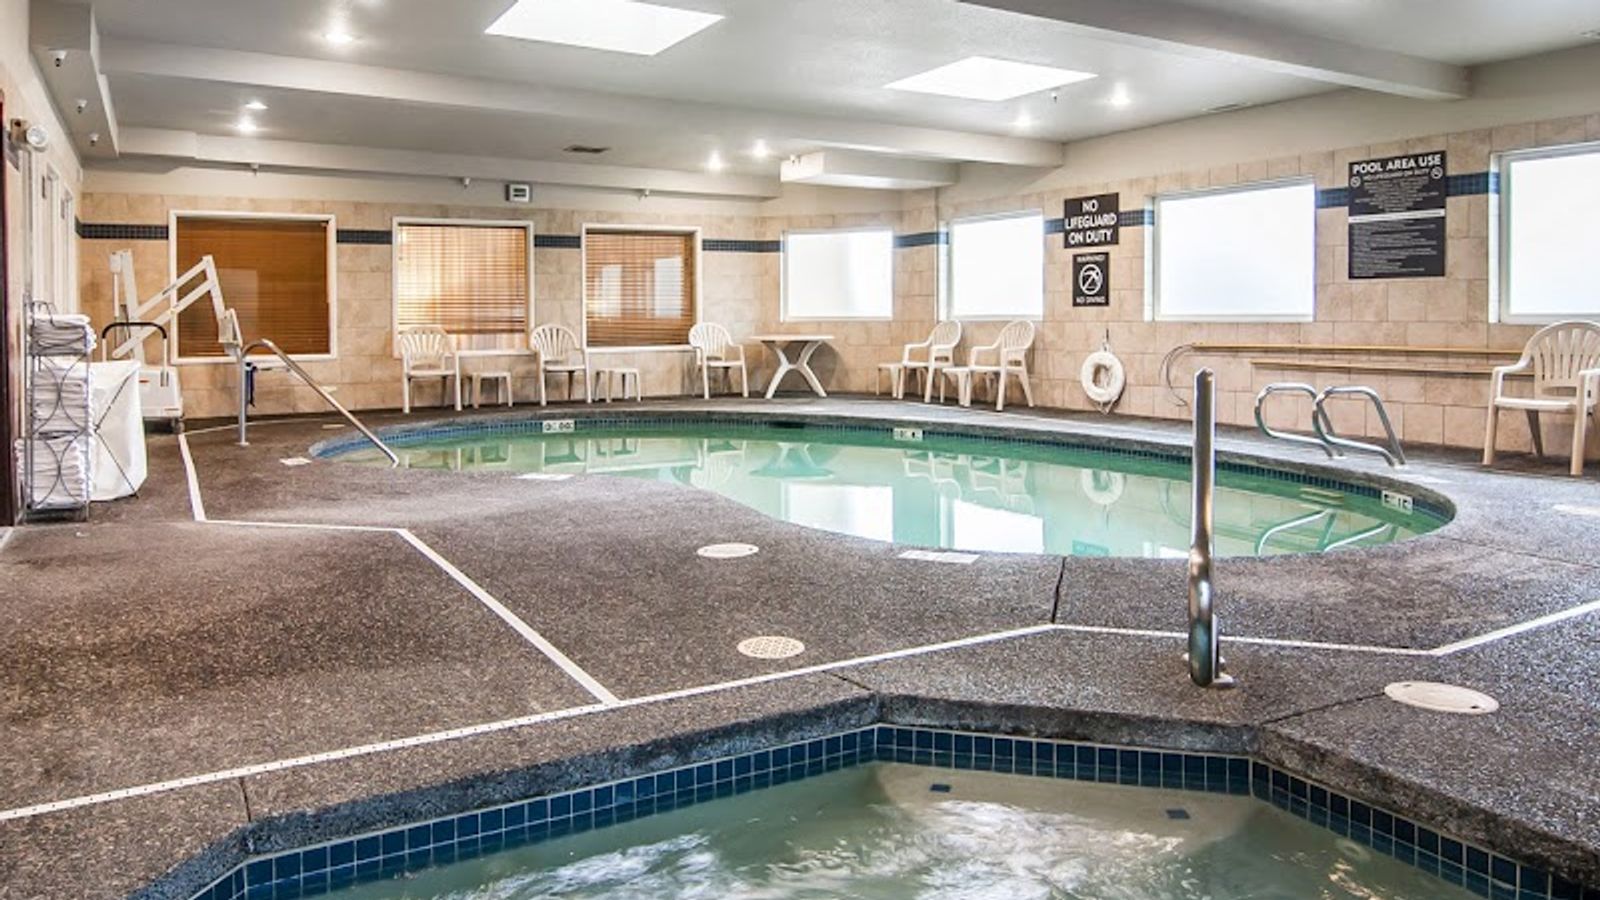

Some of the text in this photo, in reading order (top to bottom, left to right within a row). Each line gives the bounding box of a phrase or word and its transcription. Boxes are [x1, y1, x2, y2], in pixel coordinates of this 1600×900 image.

[1352, 154, 1441, 174] POOL AREA USE
[1082, 199, 1098, 213] NO
[1064, 213, 1117, 229] LIFEGUARD
[1068, 229, 1113, 245] ON DUTY
[1076, 296, 1085, 304] NO
